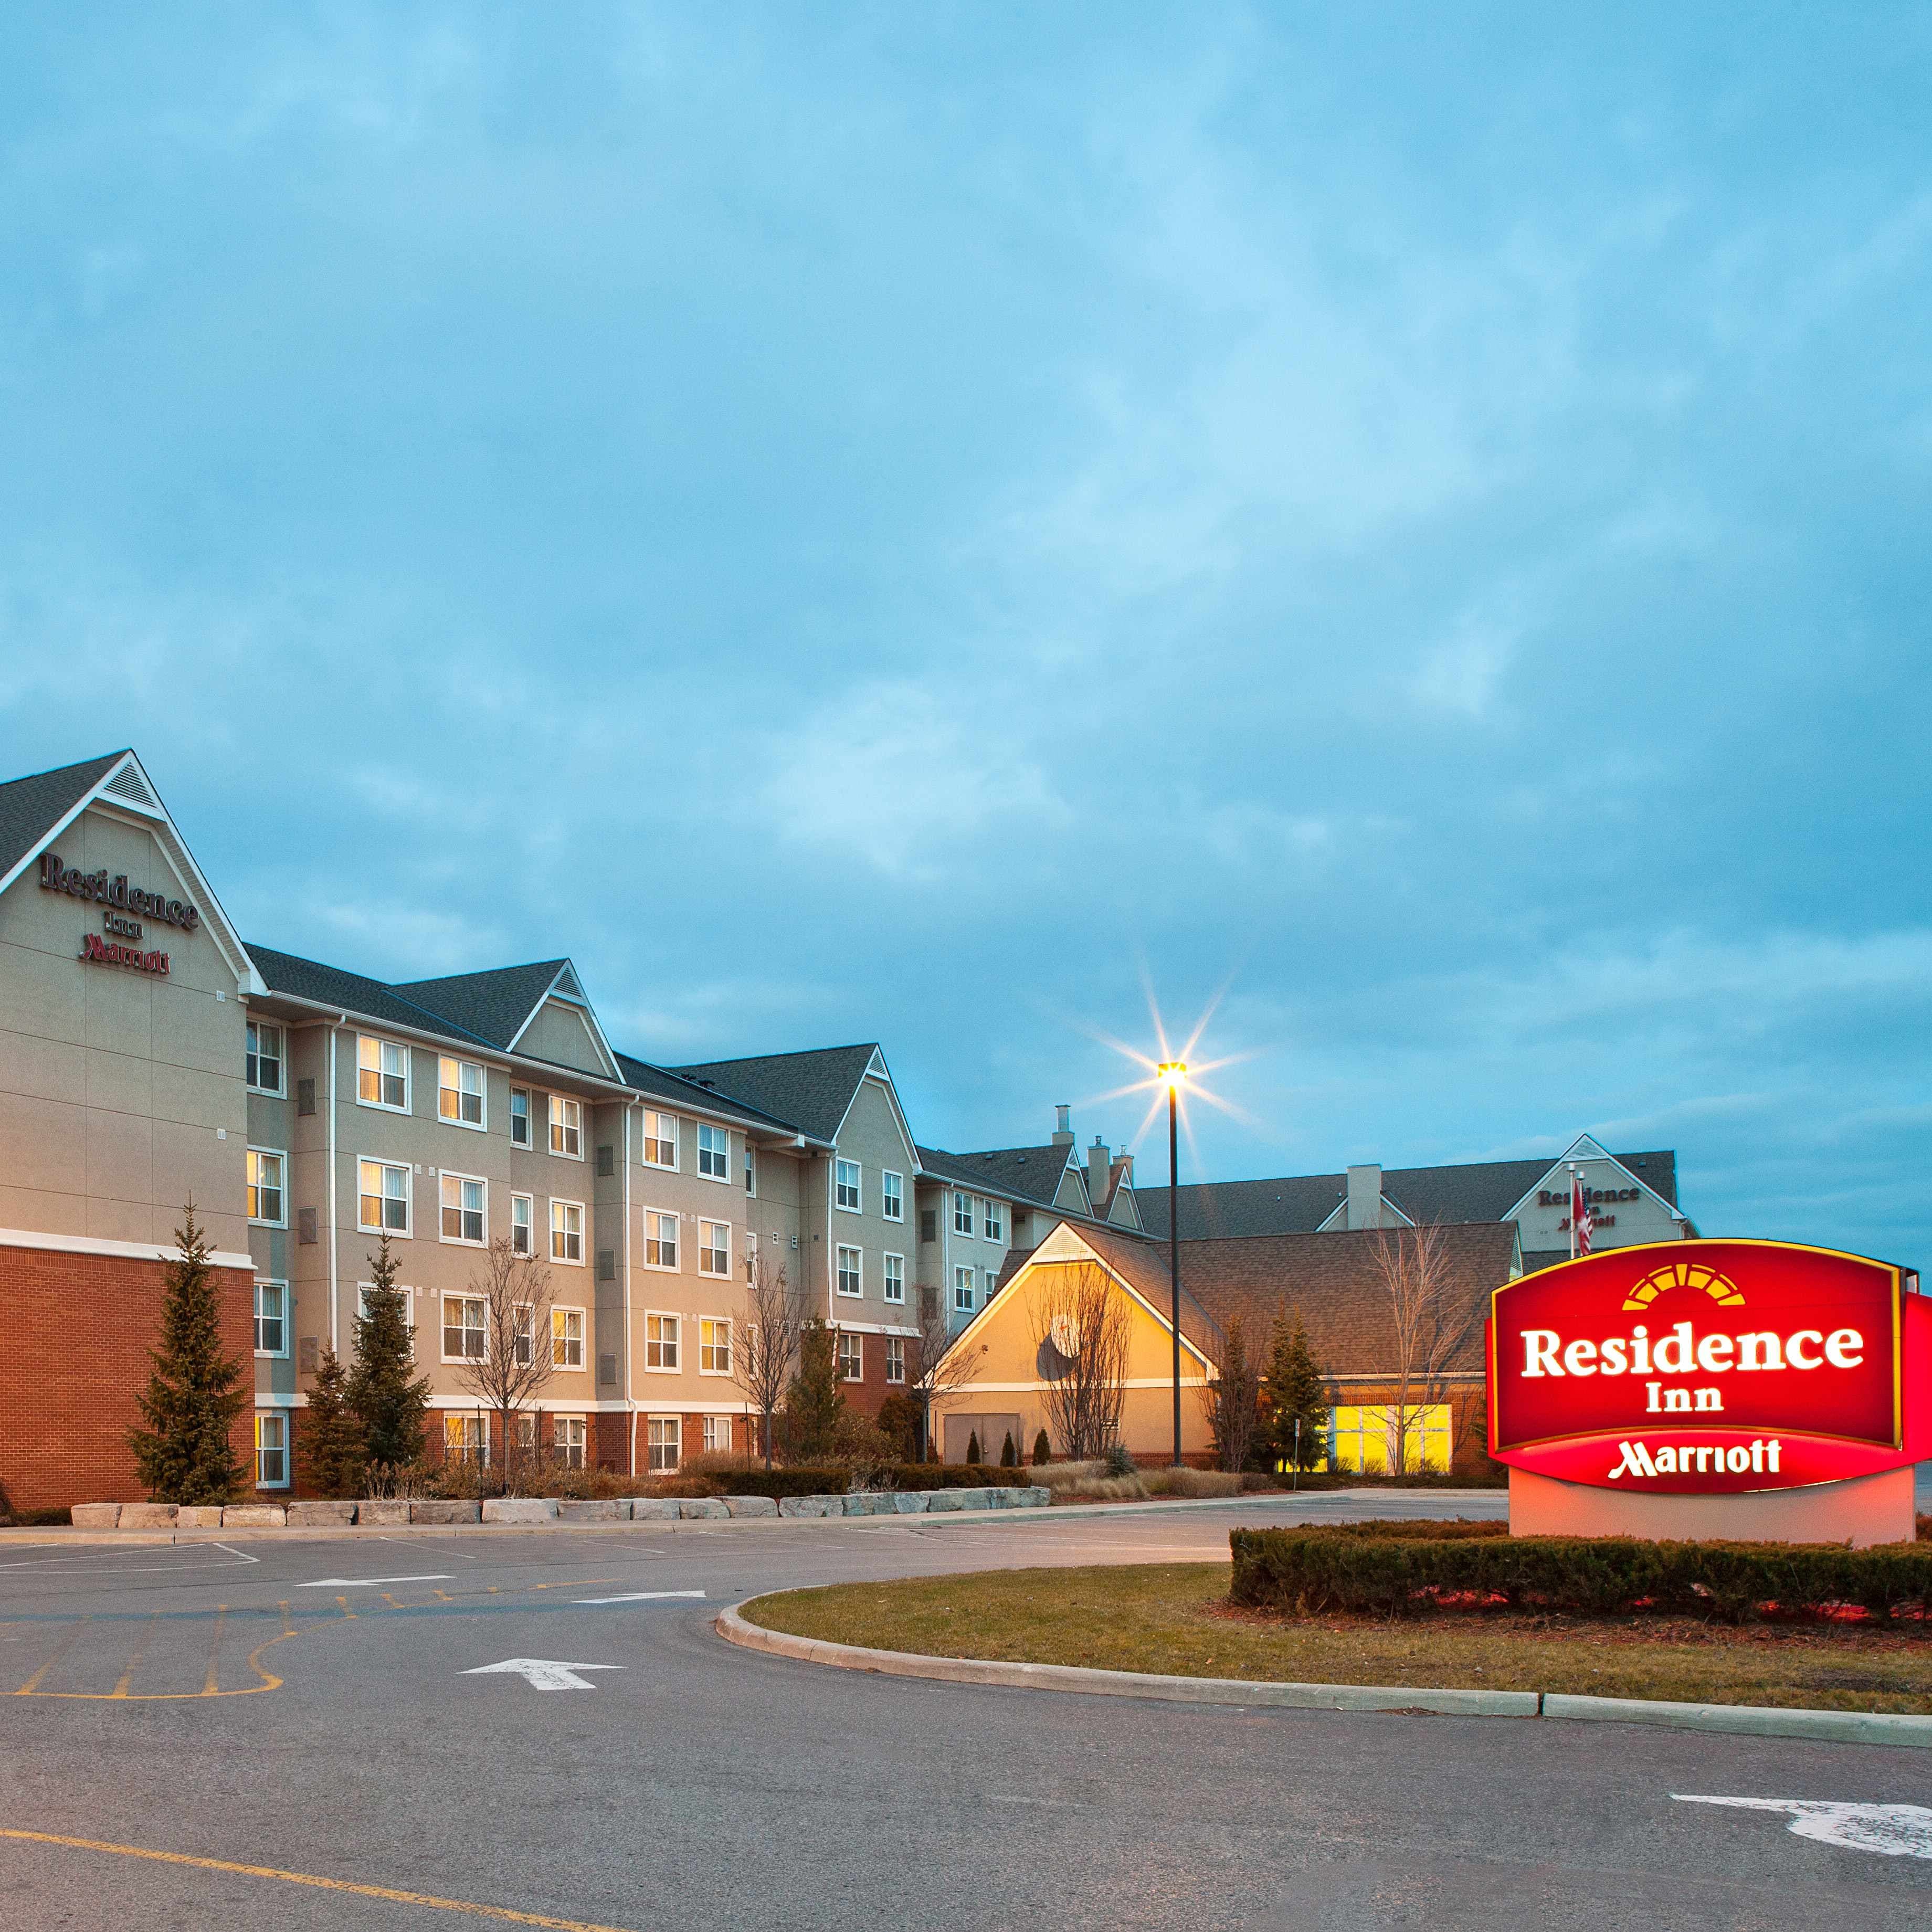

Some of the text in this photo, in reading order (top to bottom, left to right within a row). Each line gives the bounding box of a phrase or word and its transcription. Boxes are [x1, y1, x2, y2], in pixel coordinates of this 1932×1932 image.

[41, 852, 199, 930] Residence
[104, 911, 143, 939] Inn
[79, 933, 171, 975] Marriott
[1537, 1187, 1640, 1206] Resence
[1557, 1215, 1616, 1231] Miott
[1520, 1321, 1864, 1377] Residence
[1645, 1382, 1724, 1412] Inn
[1608, 1439, 1782, 1479] Marriott
